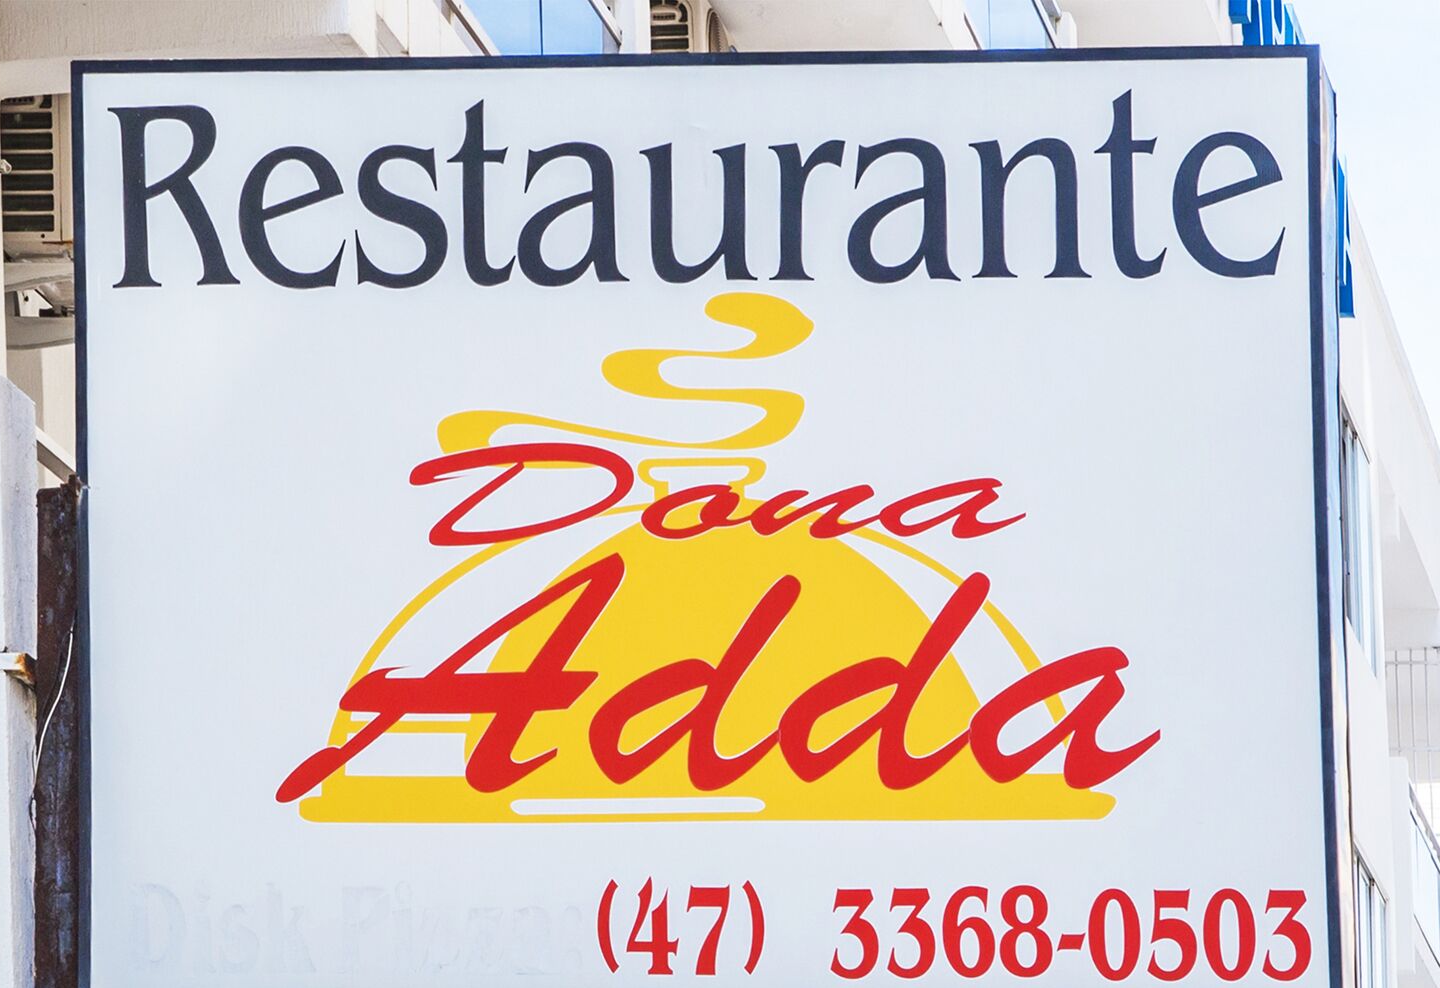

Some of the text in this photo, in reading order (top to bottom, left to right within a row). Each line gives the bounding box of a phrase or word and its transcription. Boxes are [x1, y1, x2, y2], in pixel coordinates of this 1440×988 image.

[106, 87, 1287, 289] Restaurante
[408, 441, 1026, 546] Dona
[274, 552, 1162, 804] Adda
[596, 877, 1313, 984] (47) 3368-0503
